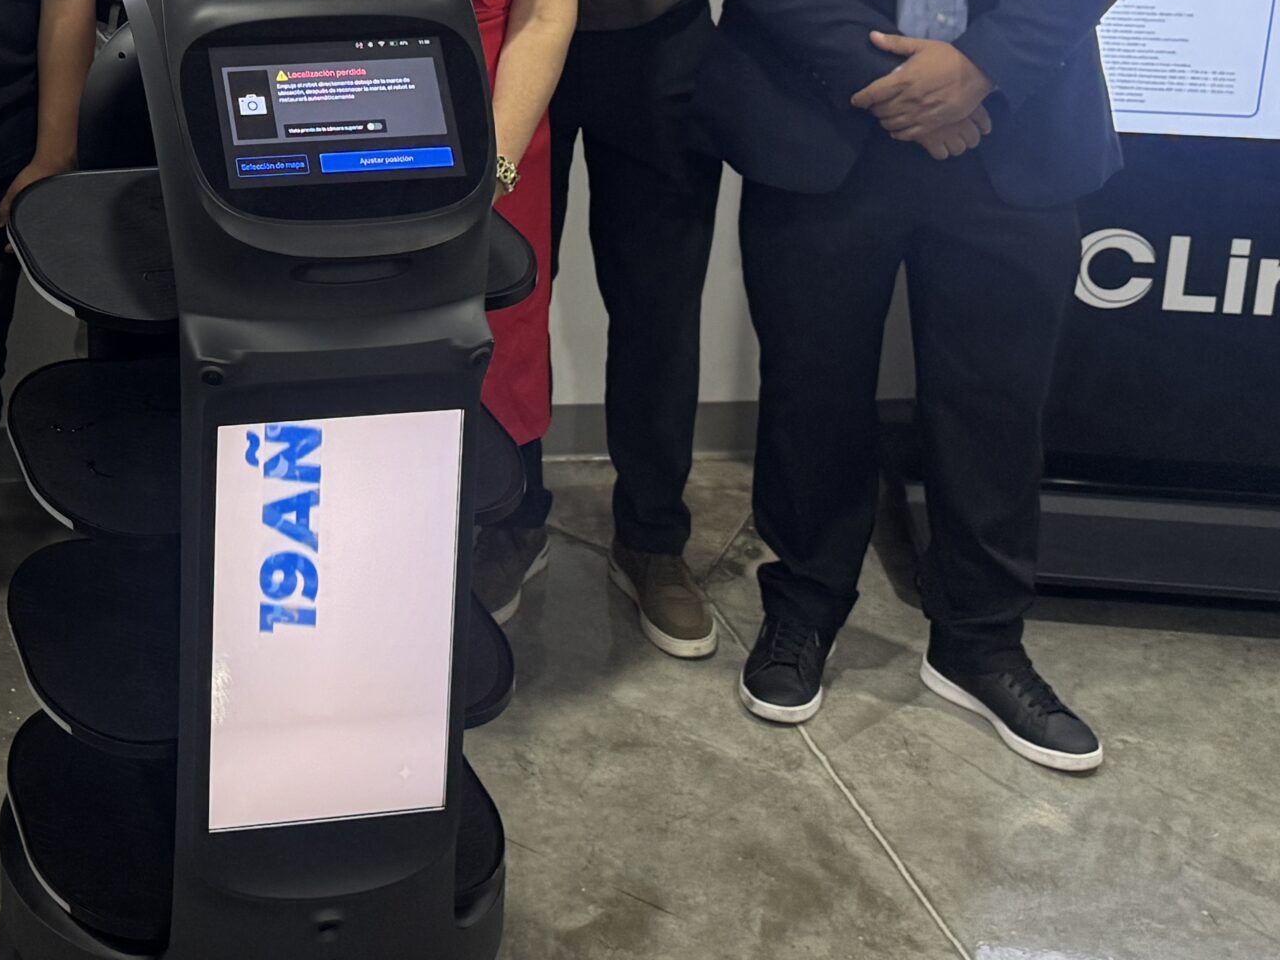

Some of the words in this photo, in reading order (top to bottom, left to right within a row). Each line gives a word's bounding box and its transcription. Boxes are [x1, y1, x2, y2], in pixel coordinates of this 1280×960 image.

[287, 68, 336, 79] Localización
[359, 155, 384, 166] Ajustar
[385, 154, 414, 165] posición
